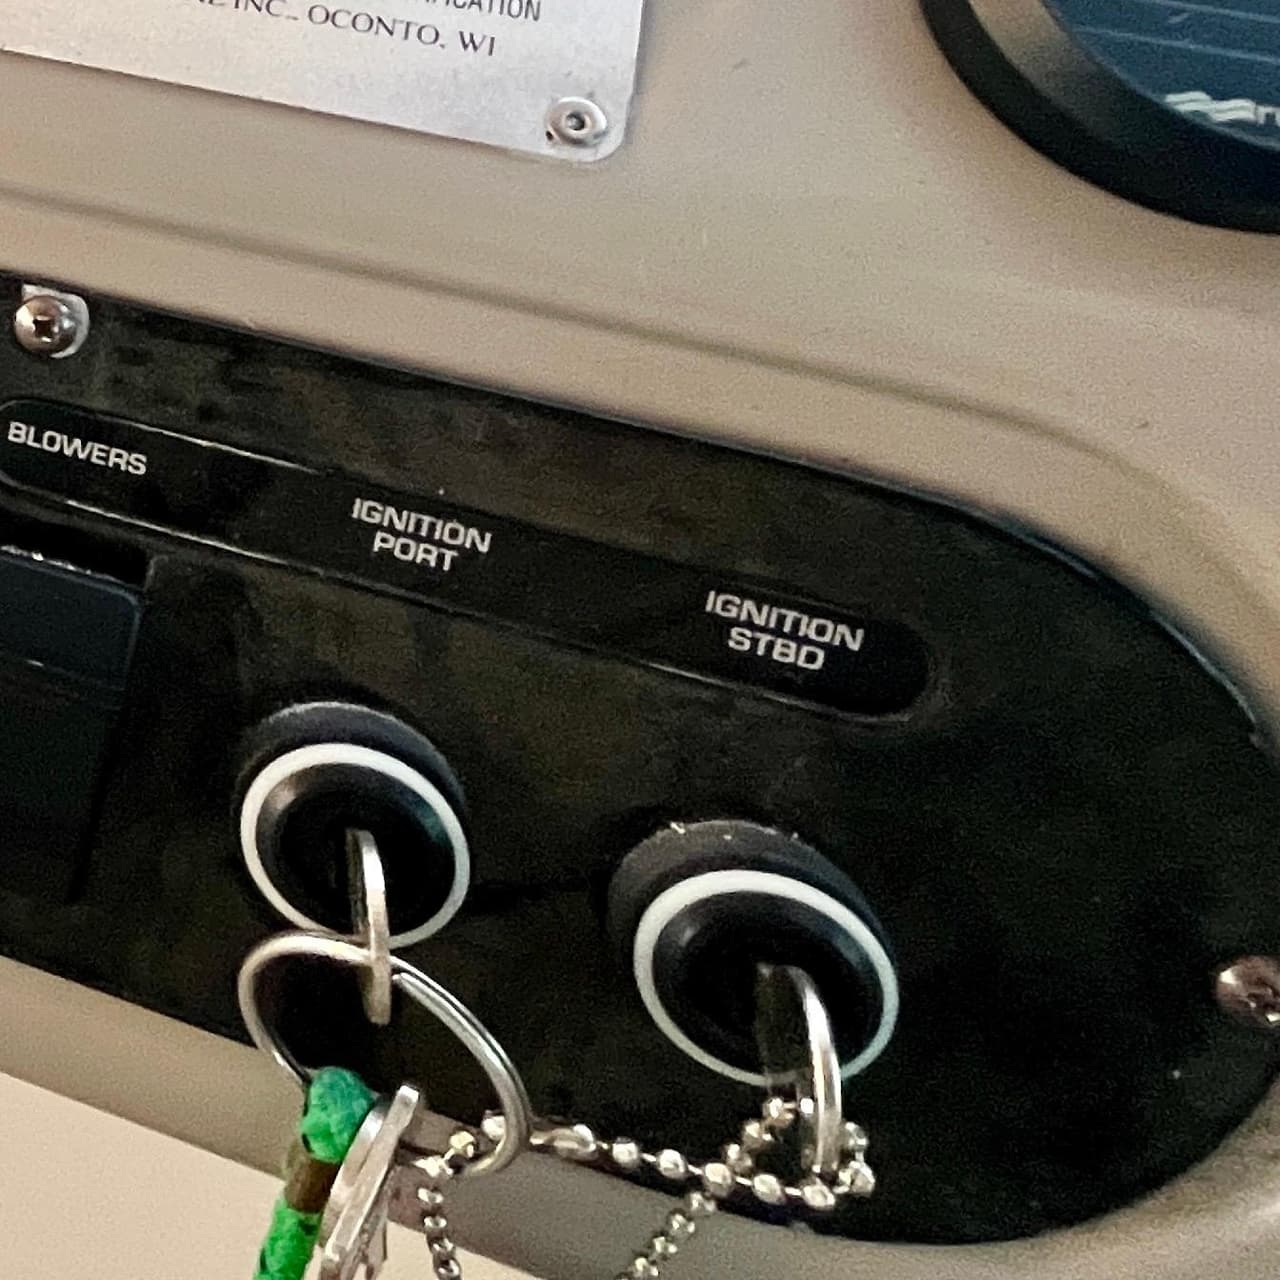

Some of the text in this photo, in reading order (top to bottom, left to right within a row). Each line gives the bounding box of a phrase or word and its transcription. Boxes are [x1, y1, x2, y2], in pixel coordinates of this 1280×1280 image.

[458, 30, 496, 57] WI
[7, 422, 147, 476] BLOWERS
[352, 498, 492, 553] IGNITION
[372, 531, 458, 572] PORT
[705, 590, 864, 651] IGNITION
[728, 626, 825, 670] STBD
